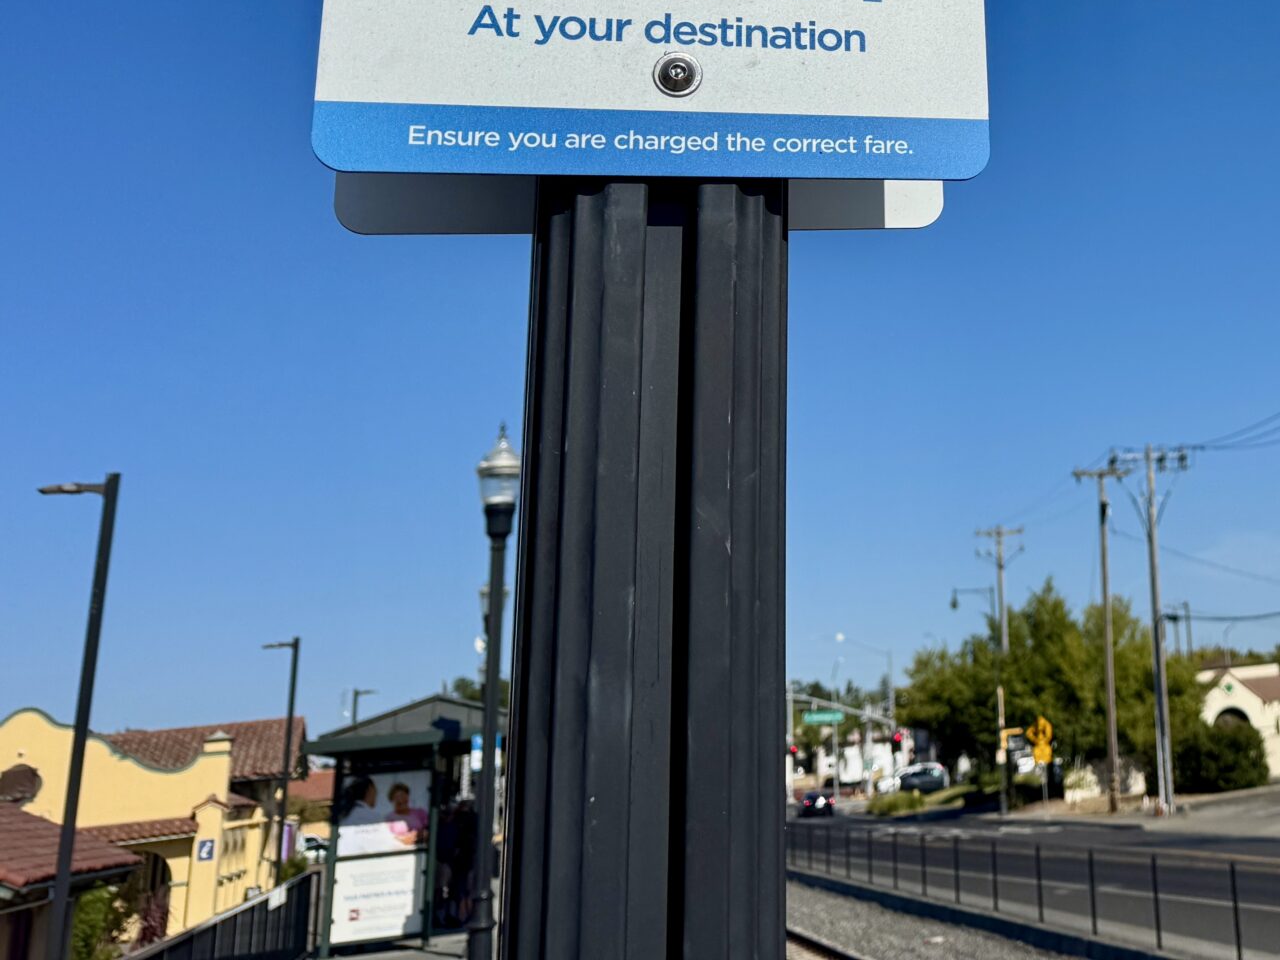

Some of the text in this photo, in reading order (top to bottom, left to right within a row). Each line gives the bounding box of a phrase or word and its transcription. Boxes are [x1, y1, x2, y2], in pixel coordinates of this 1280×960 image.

[467, 4, 866, 53] At your destination
[408, 124, 914, 156] Ensure you are charged the correct fare.
